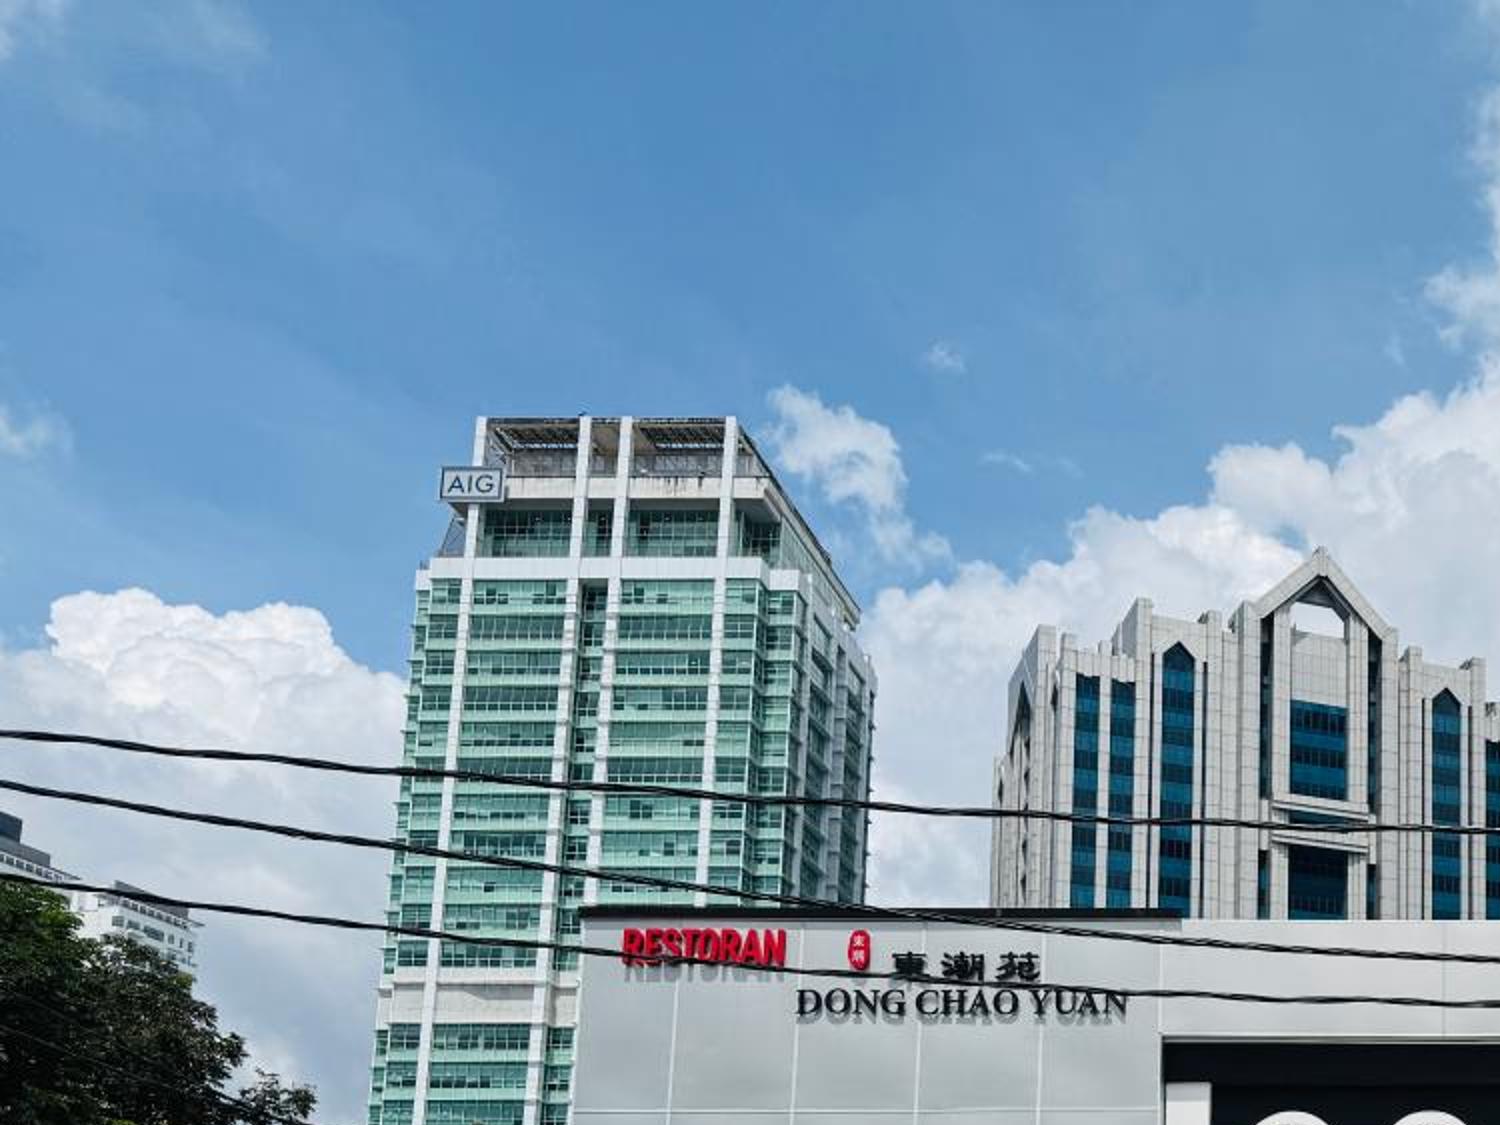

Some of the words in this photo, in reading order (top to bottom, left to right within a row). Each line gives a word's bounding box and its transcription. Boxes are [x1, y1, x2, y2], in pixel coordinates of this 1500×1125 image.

[447, 475, 494, 493] AIG
[621, 928, 787, 968] RESTORAN
[795, 988, 906, 1018] DONG
[916, 988, 1020, 1018] CHAO
[1028, 987, 1128, 1018] YUAN
